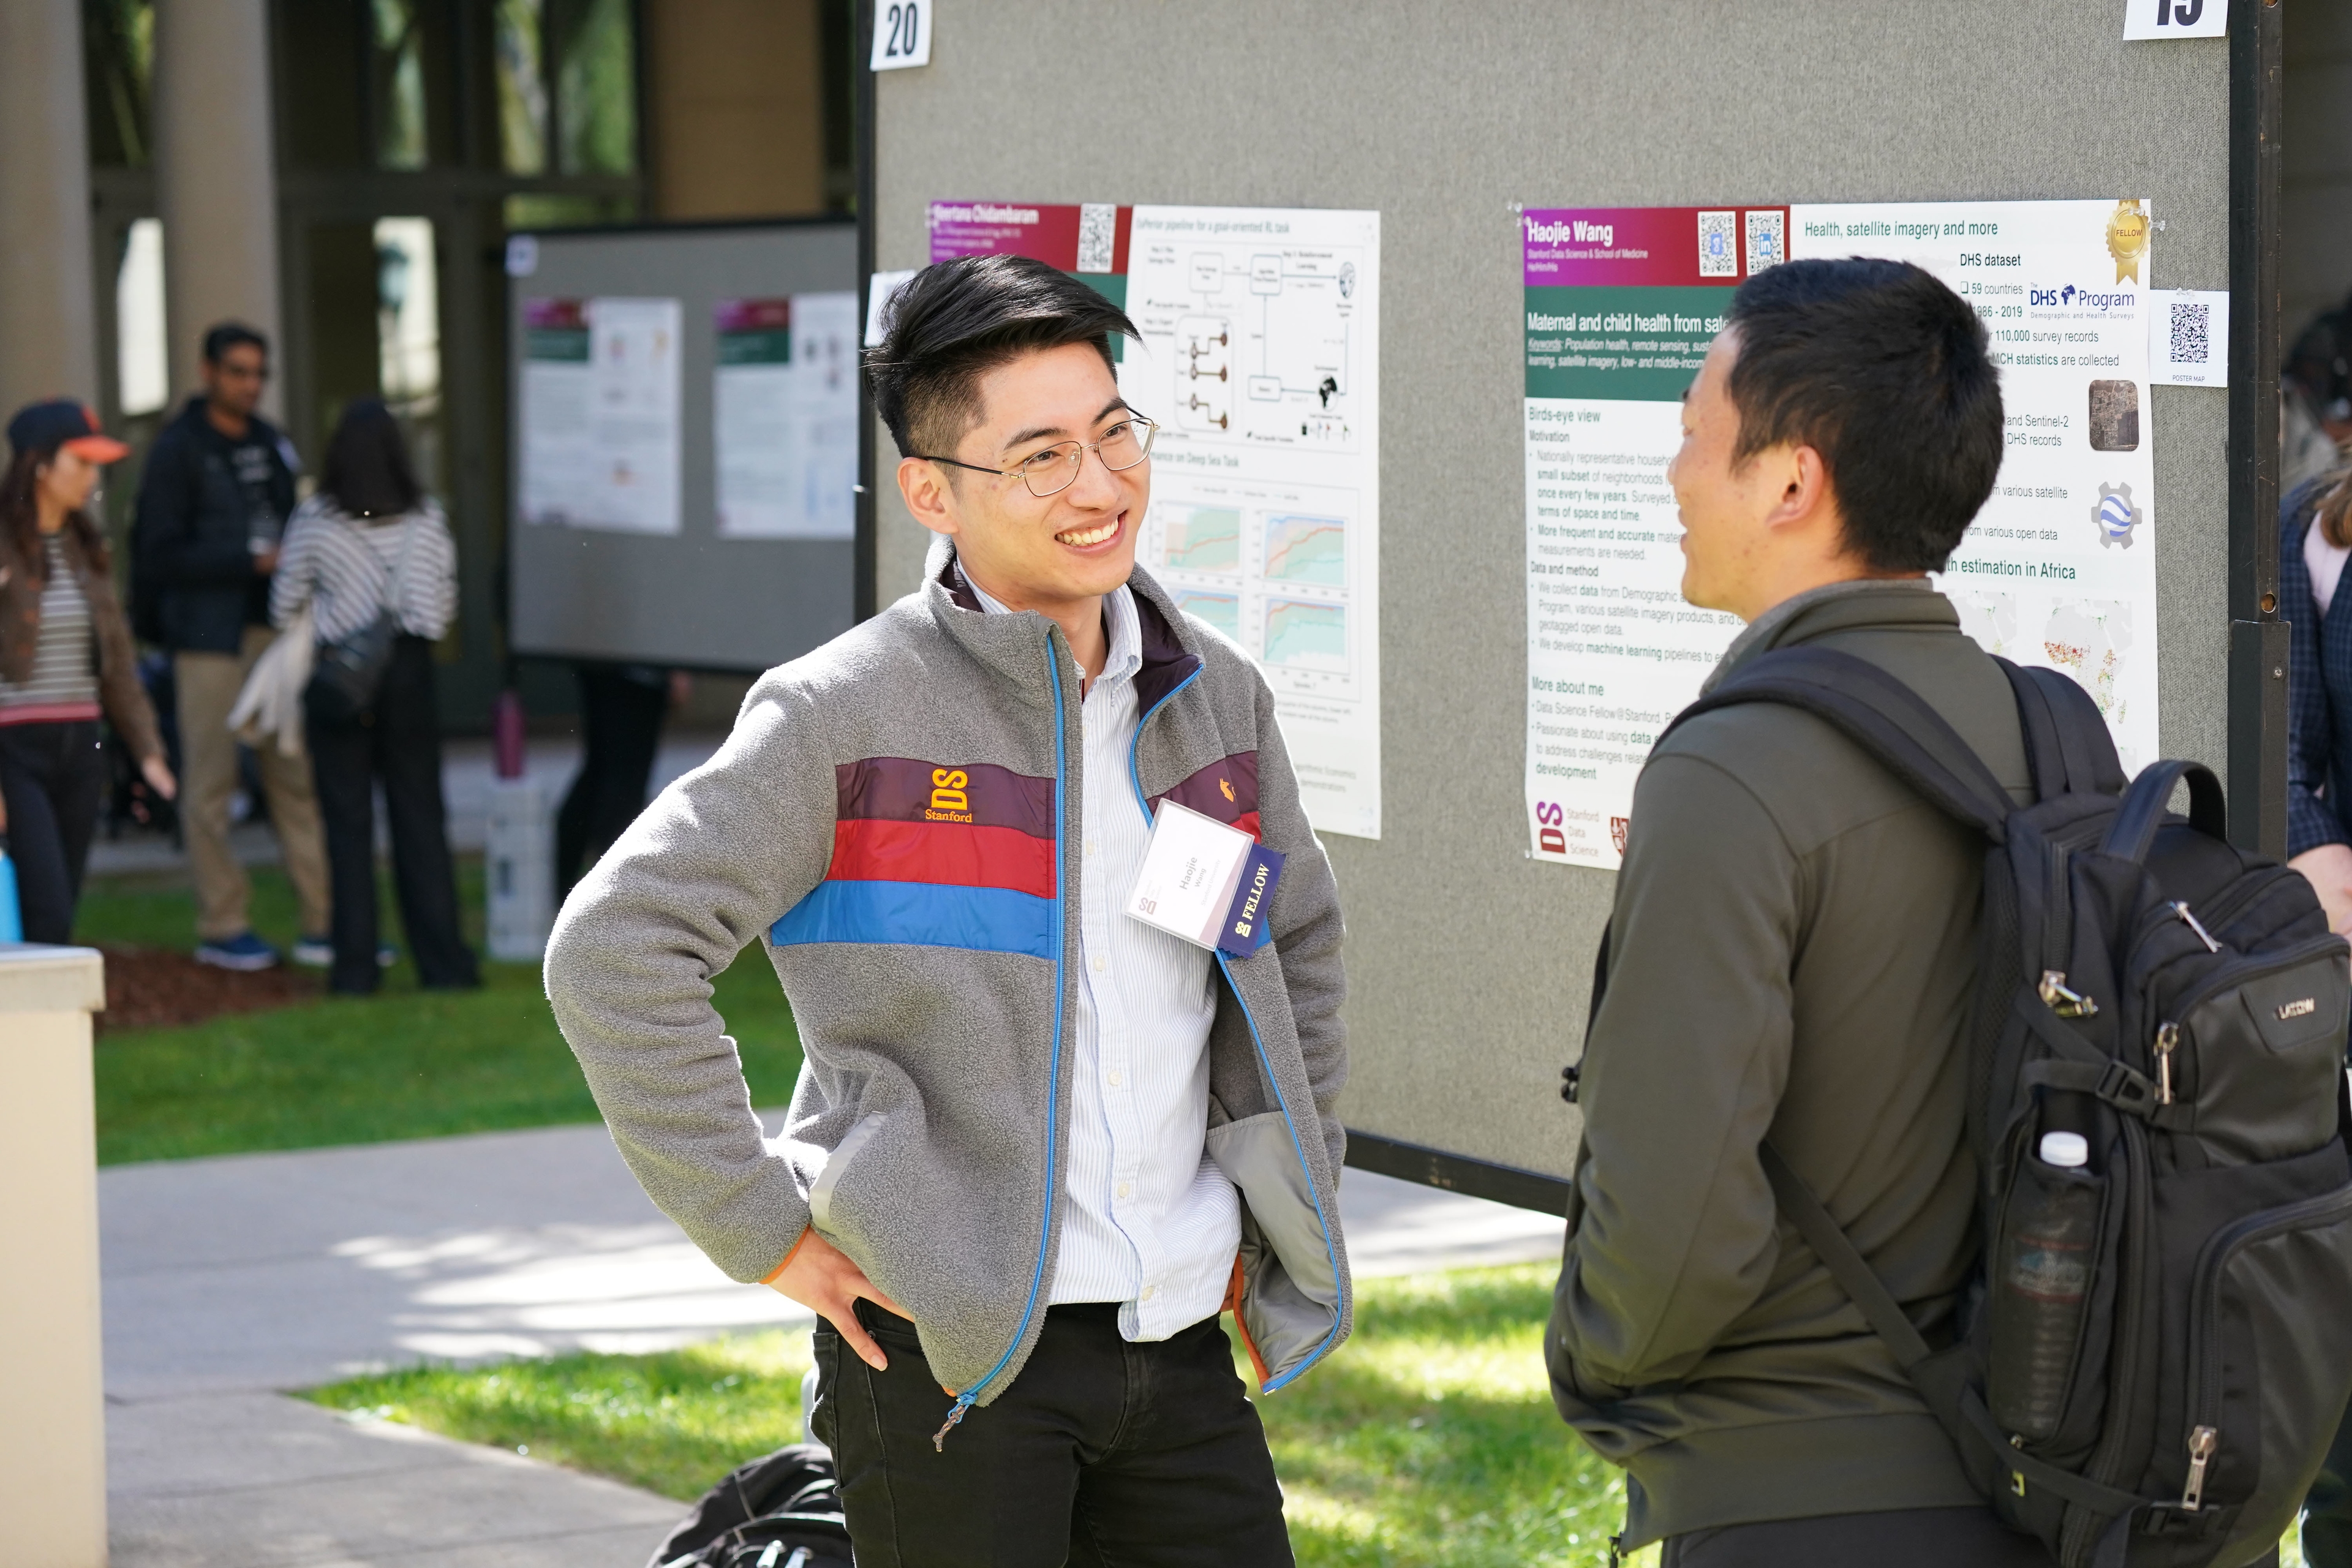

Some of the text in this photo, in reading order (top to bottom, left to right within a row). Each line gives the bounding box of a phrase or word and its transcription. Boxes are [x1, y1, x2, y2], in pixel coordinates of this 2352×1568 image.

[886, 2, 917, 56] 20
[1528, 221, 1613, 247] Haojie Wang
[1805, 221, 1998, 239] Health, satellite imagery and more
[1566, 248, 1588, 259] Science
[1594, 248, 1614, 259] School
[1622, 248, 1648, 259] Medicine
[1960, 254, 2021, 266] DHS dataset
[1972, 282, 2023, 295] 59 countries
[2030, 290, 2135, 311] DHS Program
[2001, 306, 2022, 317] 2019
[2030, 312, 2070, 320] Demographic
[2109, 312, 2135, 320] Surveys
[1528, 312, 1702, 333] Maternal and child health from
[1564, 337, 1604, 352] Population
[1605, 338, 1630, 352] health,
[1632, 339, 1659, 352] remote
[1659, 339, 1691, 354] sensing,
[1996, 330, 2030, 344] 110,000
[2032, 331, 2062, 345] survey
[2065, 330, 2099, 342] records
[1558, 355, 1586, 367] satellite
[1588, 355, 1619, 370] imagery,
[1621, 355, 1637, 368] low-
[1638, 356, 1653, 368] and
[2016, 353, 2059, 366] statistics
[2061, 355, 2075, 366] are
[2078, 354, 2119, 366] collected
[1529, 407, 1600, 424] Birds-eye view
[2007, 414, 2069, 428] and Sentinel-2
[1529, 430, 1570, 442] Motivation
[2007, 432, 2062, 447] DHS records
[1537, 450, 1635, 466] Nationally representative
[1538, 469, 1663, 486] small subset of neighborhoods
[1537, 488, 1556, 498] once
[1559, 489, 1581, 502] every
[1585, 489, 1599, 500] few
[1632, 490, 1671, 506] Surveyed
[2003, 485, 2033, 497] various
[2035, 486, 2068, 499] satellite
[1537, 506, 1642, 521] terms of space and time.
[1538, 524, 1655, 542] More frequent and accurate
[1984, 526, 2058, 541] various open data
[1537, 545, 1647, 560] measurements are needed.
[1549, 563, 1563, 575] and
[1566, 565, 1599, 577] method
[1961, 558, 2076, 579] estimation in Africa
[1539, 582, 1550, 594] We
[1552, 583, 1577, 596] collect
[1580, 585, 1598, 597] data
[1600, 586, 1619, 598] from
[1622, 587, 1678, 604] Demographic
[1539, 600, 1572, 616] Program,
[1575, 603, 1605, 616] various
[1607, 605, 1638, 619] satellite
[1642, 607, 1674, 624] imagery
[1676, 608, 1716, 625] products,
[1719, 612, 1735, 625] and
[1539, 620, 1624, 636] geotagged open data.
[1539, 639, 1551, 650] We
[1553, 639, 1585, 654] develop
[1586, 643, 1624, 655] machine
[1626, 644, 1662, 662] learning
[1665, 647, 1702, 663] pipelines
[1705, 650, 1713, 663] to
[1532, 676, 1604, 696] More about me
[1536, 700, 1553, 714] Data
[1555, 703, 1587, 717] Science
[1536, 722, 1578, 736] Passionate
[1581, 726, 1604, 740] about
[1606, 729, 1628, 745] using
[1630, 731, 1651, 745] data
[1536, 743, 1623, 764] to address challenges
[1536, 763, 1597, 780] development
[925, 809, 973, 823] Stanford
[1567, 809, 1599, 822] Stanford
[1568, 826, 1586, 838] Data
[1570, 843, 1599, 858] Science
[1179, 857, 1197, 890] Haojie
[1194, 868, 1207, 888] Wang
[1200, 859, 1221, 907] Stanford University
[1242, 863, 1270, 921] FELLOW
